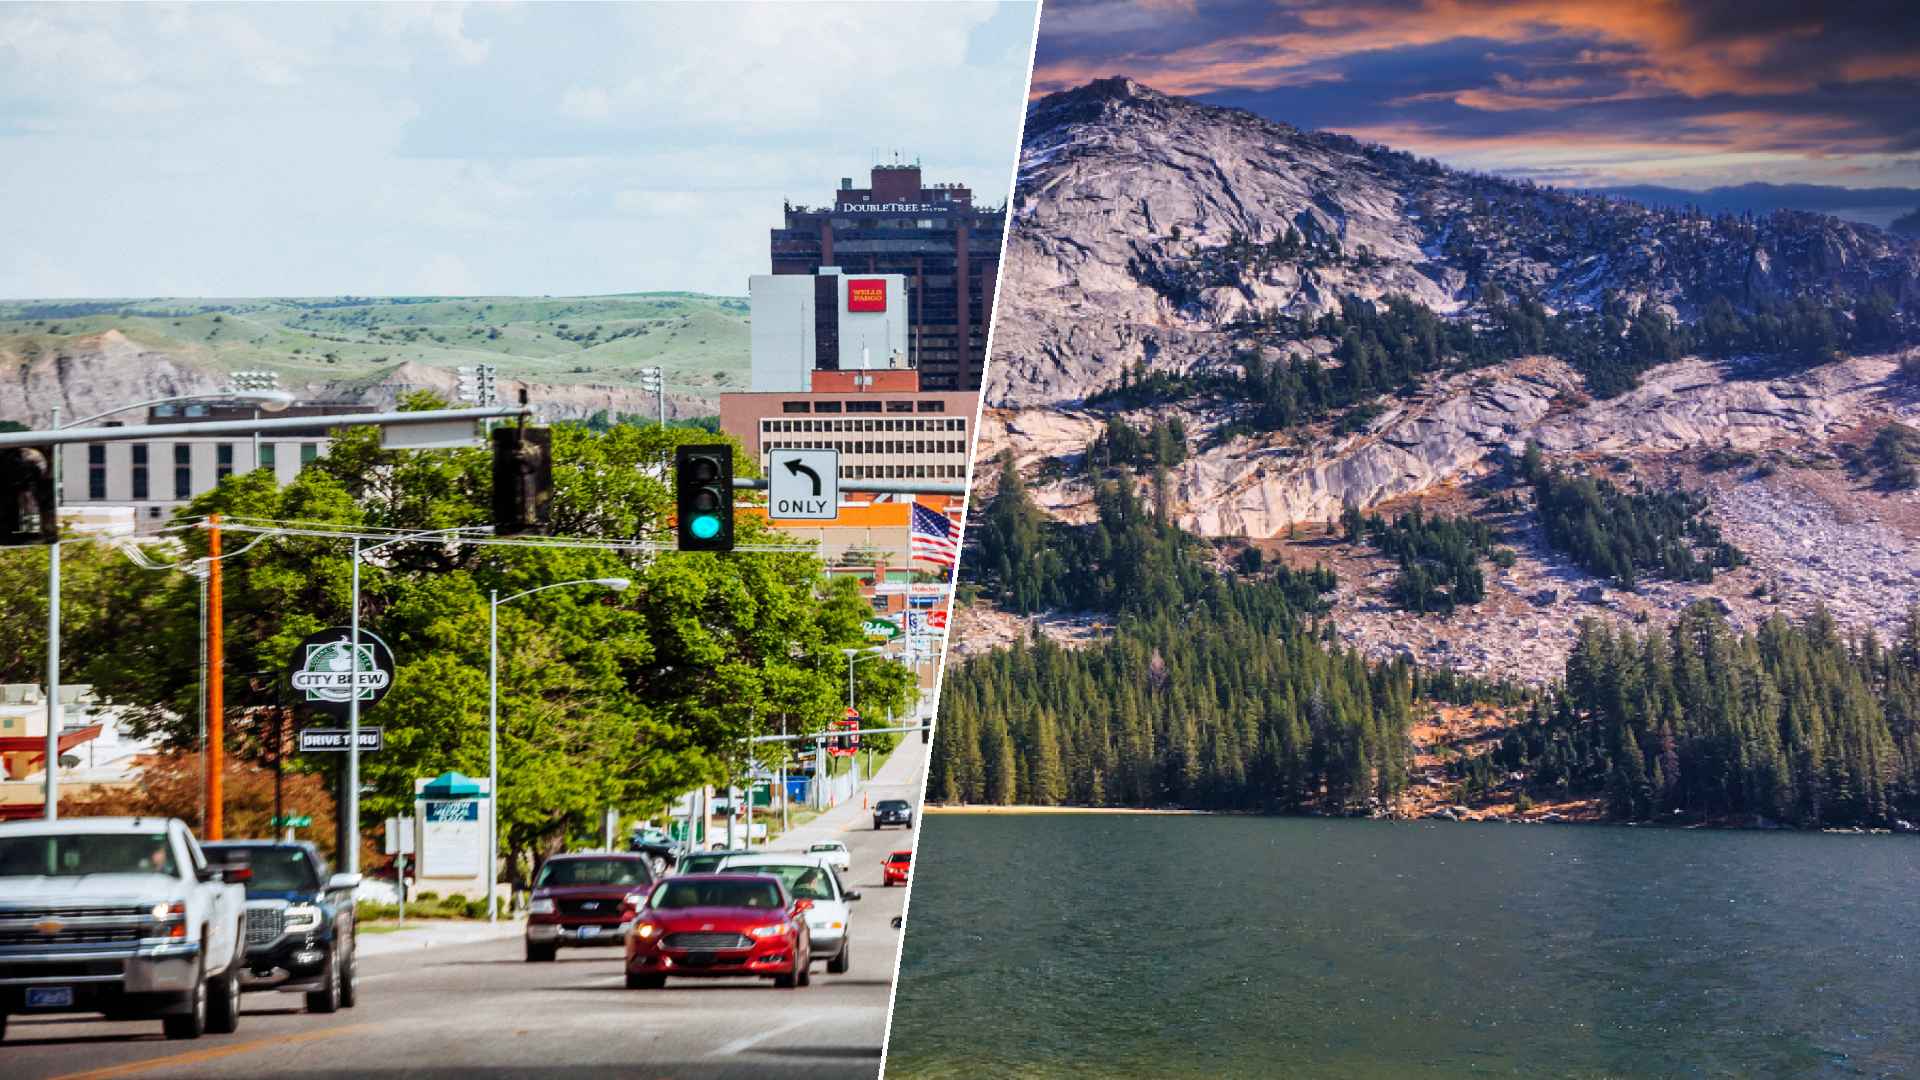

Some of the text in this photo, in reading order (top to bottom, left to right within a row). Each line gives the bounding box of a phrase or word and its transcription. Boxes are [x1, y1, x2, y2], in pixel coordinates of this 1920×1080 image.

[778, 500, 827, 513] ONLY
[297, 674, 331, 685] CITY
[303, 734, 377, 746] DRIVE TRU
